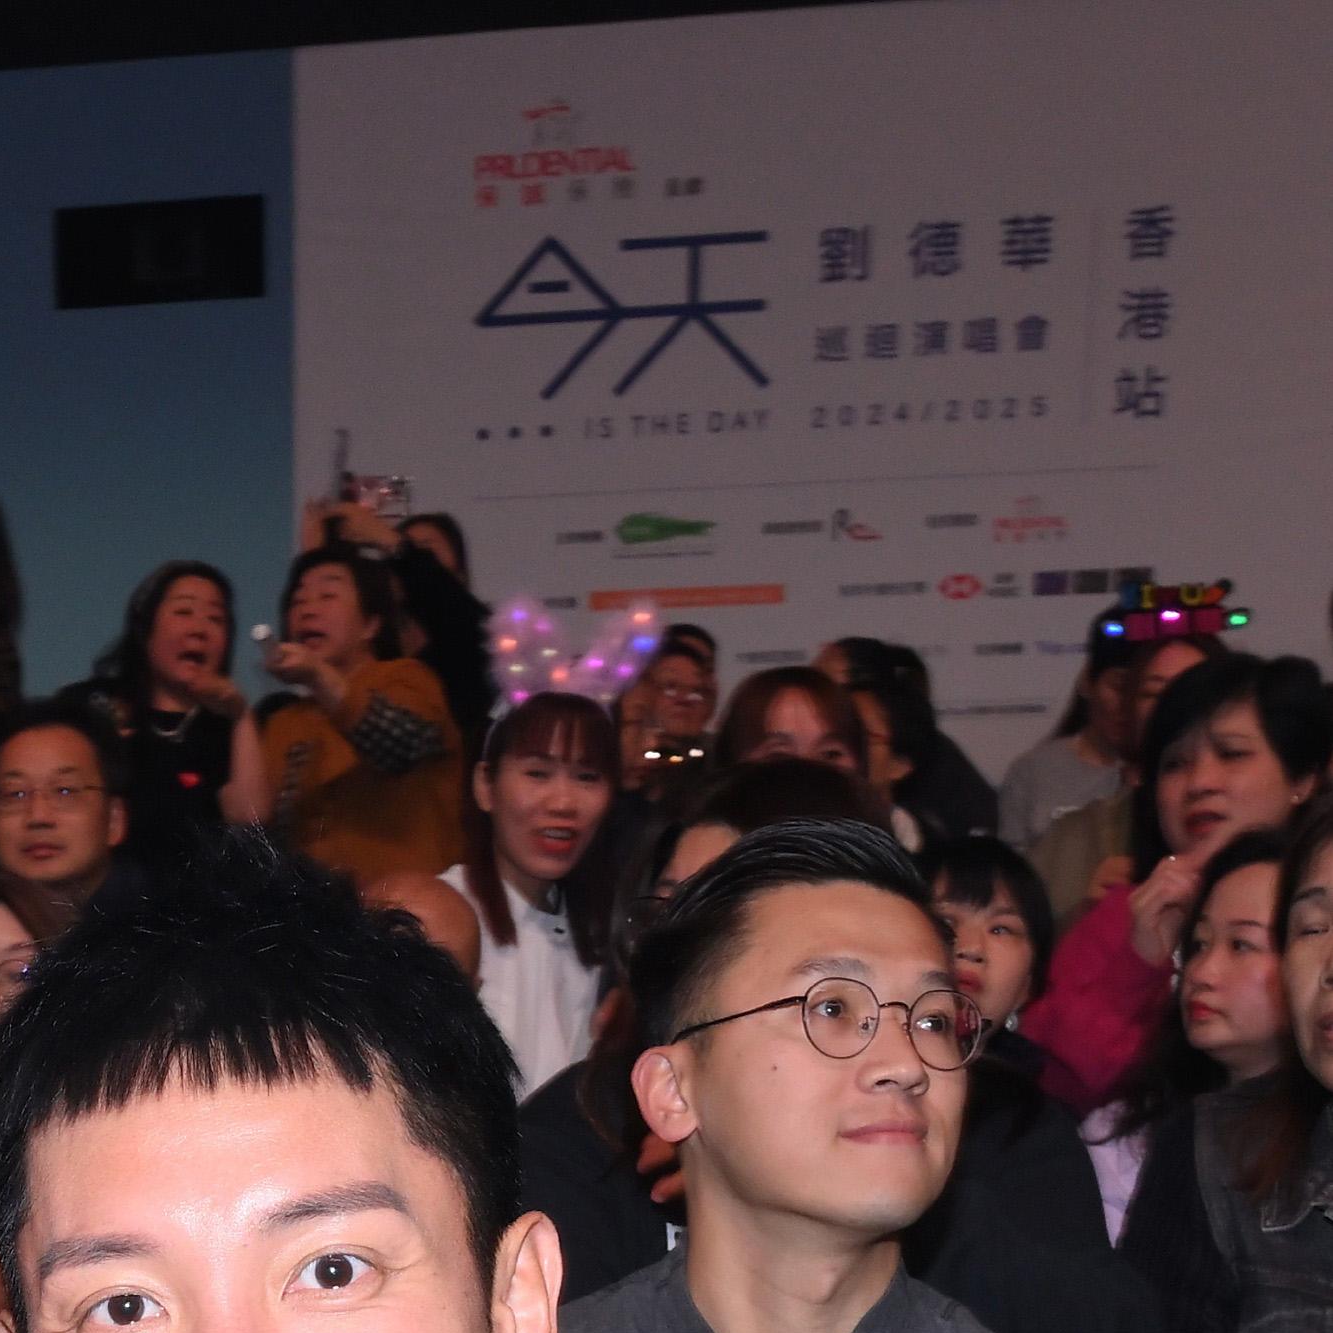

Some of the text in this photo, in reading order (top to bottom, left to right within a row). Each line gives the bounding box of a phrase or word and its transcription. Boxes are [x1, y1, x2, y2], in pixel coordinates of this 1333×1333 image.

[819, 215, 1054, 283] 劉德華
[1114, 205, 1174, 418] 香港站
[584, 409, 770, 439] IS THE DAY
[811, 396, 1050, 428] 2024/2025
